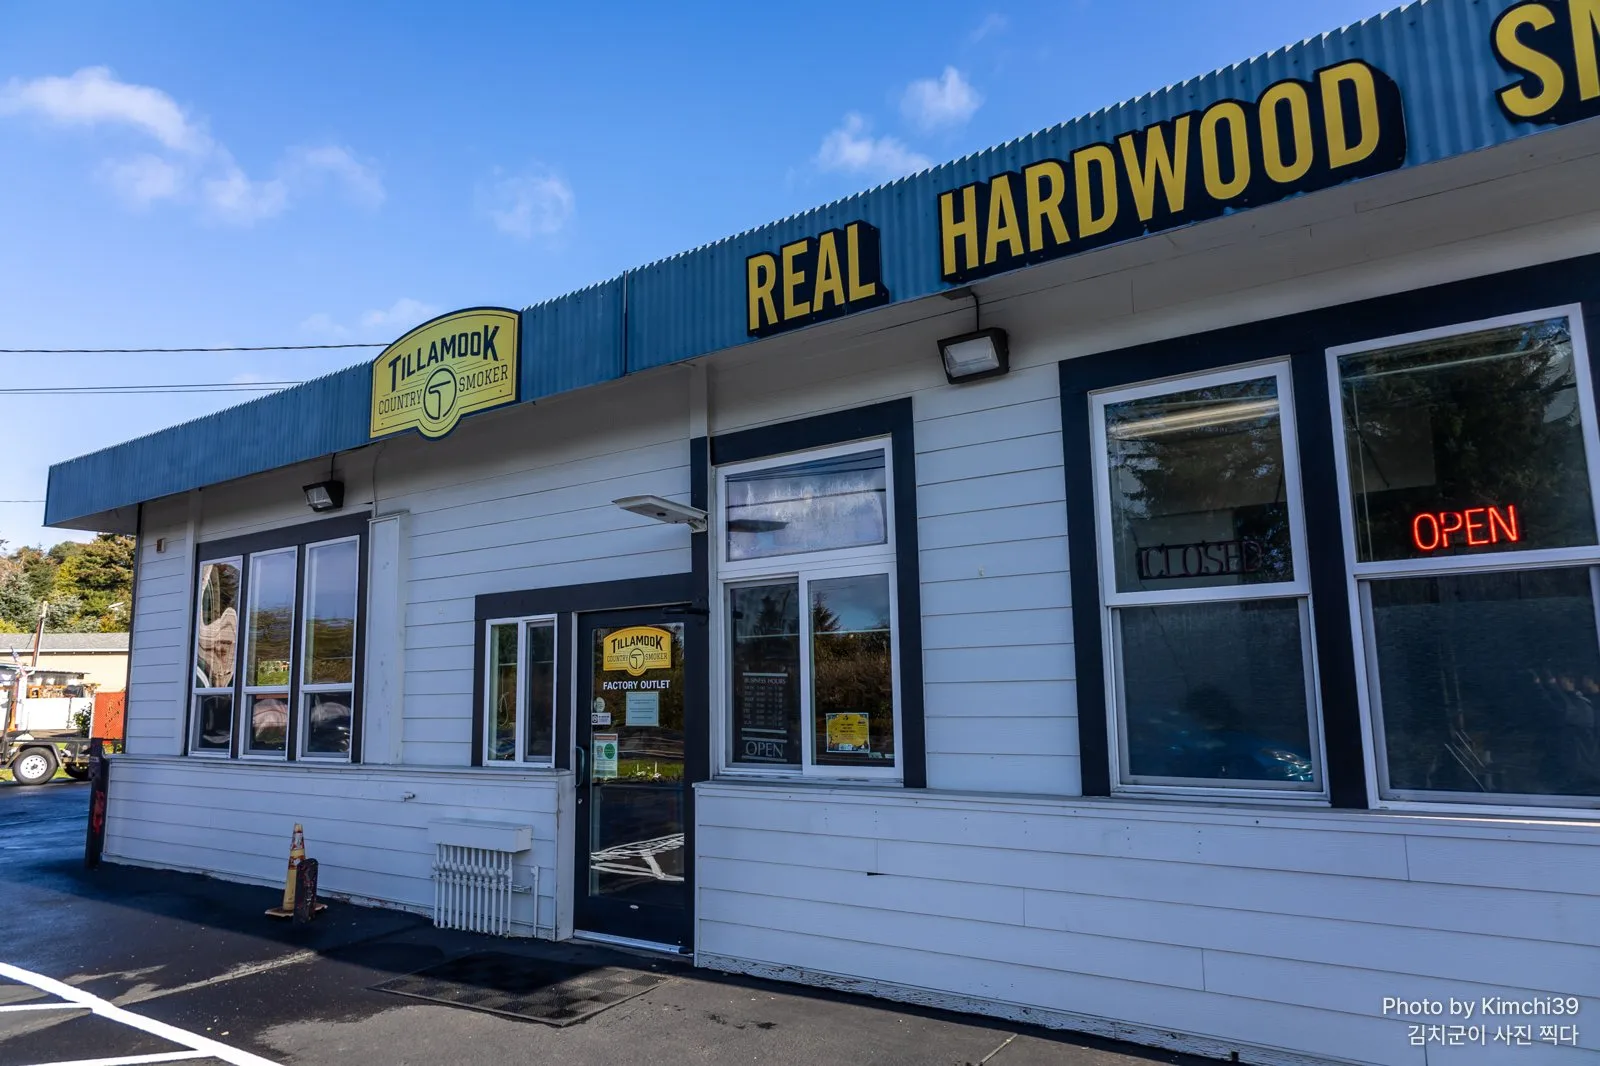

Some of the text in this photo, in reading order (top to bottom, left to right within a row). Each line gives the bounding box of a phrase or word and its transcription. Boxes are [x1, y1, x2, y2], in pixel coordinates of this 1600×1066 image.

[748, 223, 876, 331] REAL
[939, 62, 1381, 276] HARDWOOD
[388, 324, 500, 393] TILLAMOOK
[378, 364, 508, 415] COUNTRY SMOKER
[1413, 504, 1519, 550] OPEN
[606, 653, 668, 663] COUNTRY SMOKER
[611, 635, 664, 653] TILLAMOOK
[603, 680, 671, 690] FACTORY OUTLET
[745, 741, 784, 758] OPEN
